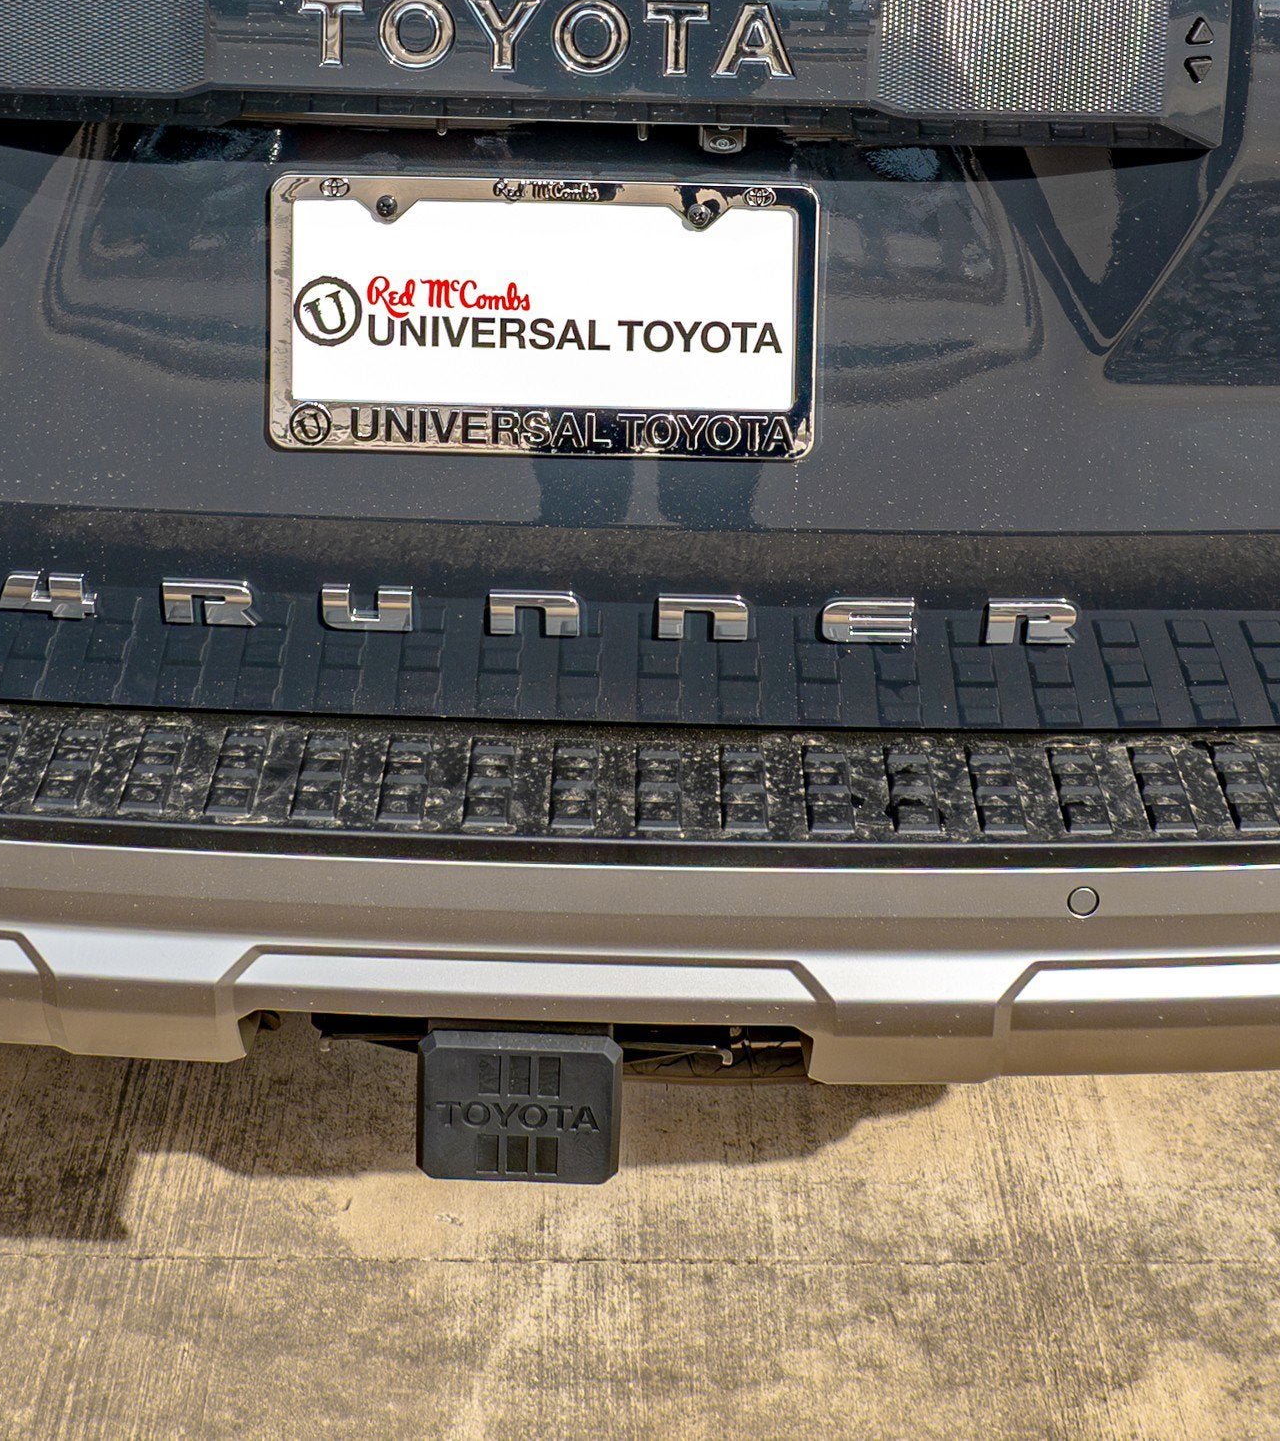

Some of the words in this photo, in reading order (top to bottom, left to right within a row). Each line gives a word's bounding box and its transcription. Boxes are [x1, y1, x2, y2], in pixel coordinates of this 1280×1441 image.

[367, 276, 415, 319] Red
[420, 278, 531, 311] McCombs
[368, 314, 610, 351] UNIVERSAL
[618, 319, 783, 354] TOYOTA
[350, 406, 613, 449] UNIVERSAL
[617, 412, 795, 452] TOYOTA
[435, 1100, 600, 1133] TOYOTA
